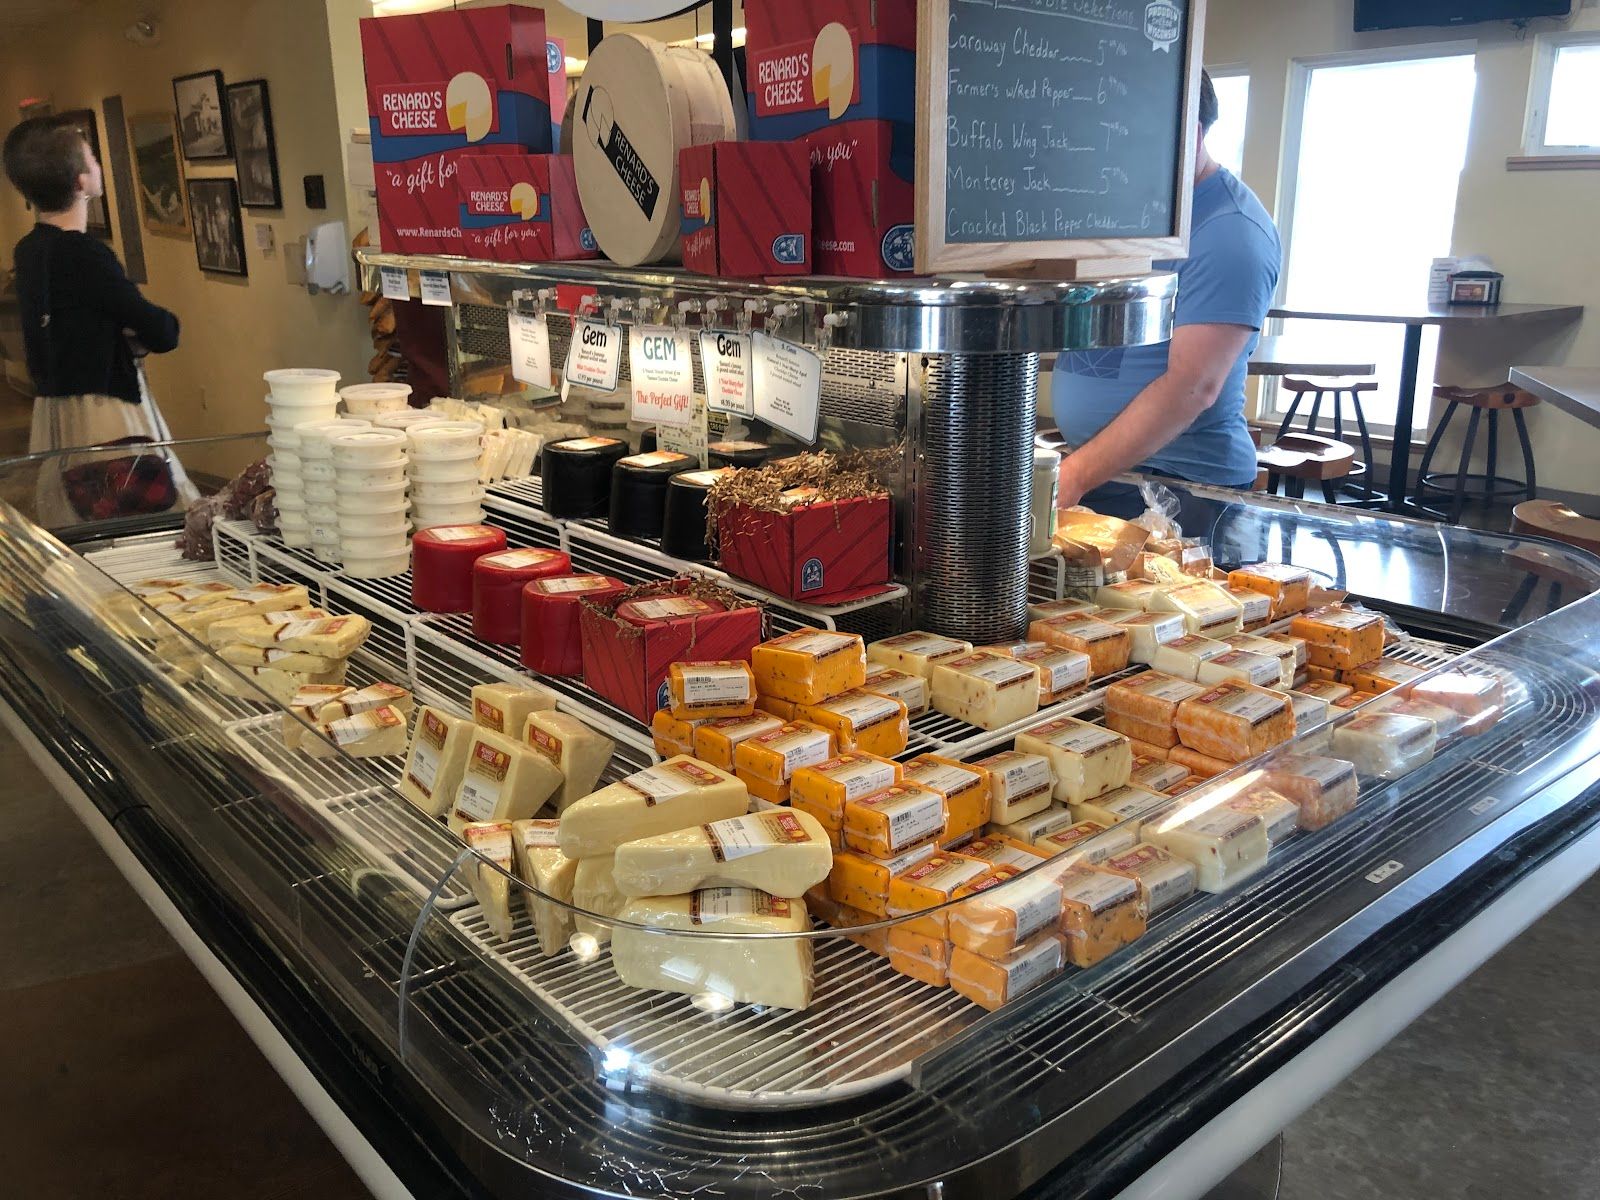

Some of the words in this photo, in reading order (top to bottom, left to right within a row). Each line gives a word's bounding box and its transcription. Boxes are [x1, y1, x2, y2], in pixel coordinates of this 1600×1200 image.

[757, 53, 809, 84] RENARD'S
[383, 91, 442, 111] RENARD'S
[765, 80, 804, 107] CHEESE
[391, 110, 437, 129] CHEESE
[947, 115, 1003, 150] Buffalo
[1012, 123, 1037, 158] Wing
[613, 129, 656, 195] RENARD'S
[826, 139, 858, 173] you"
[406, 160, 435, 195] gift
[438, 154, 458, 189] for
[614, 154, 647, 205] CHEESE
[470, 191, 509, 203] RENARD'S
[475, 201, 505, 212] CHEESE
[484, 229, 502, 248] gift
[504, 226, 519, 245] for
[582, 324, 607, 347] Gem
[717, 334, 741, 358] Gem
[643, 336, 676, 360] GEM
[636, 390, 648, 404] The
[649, 391, 672, 410] Perfect
